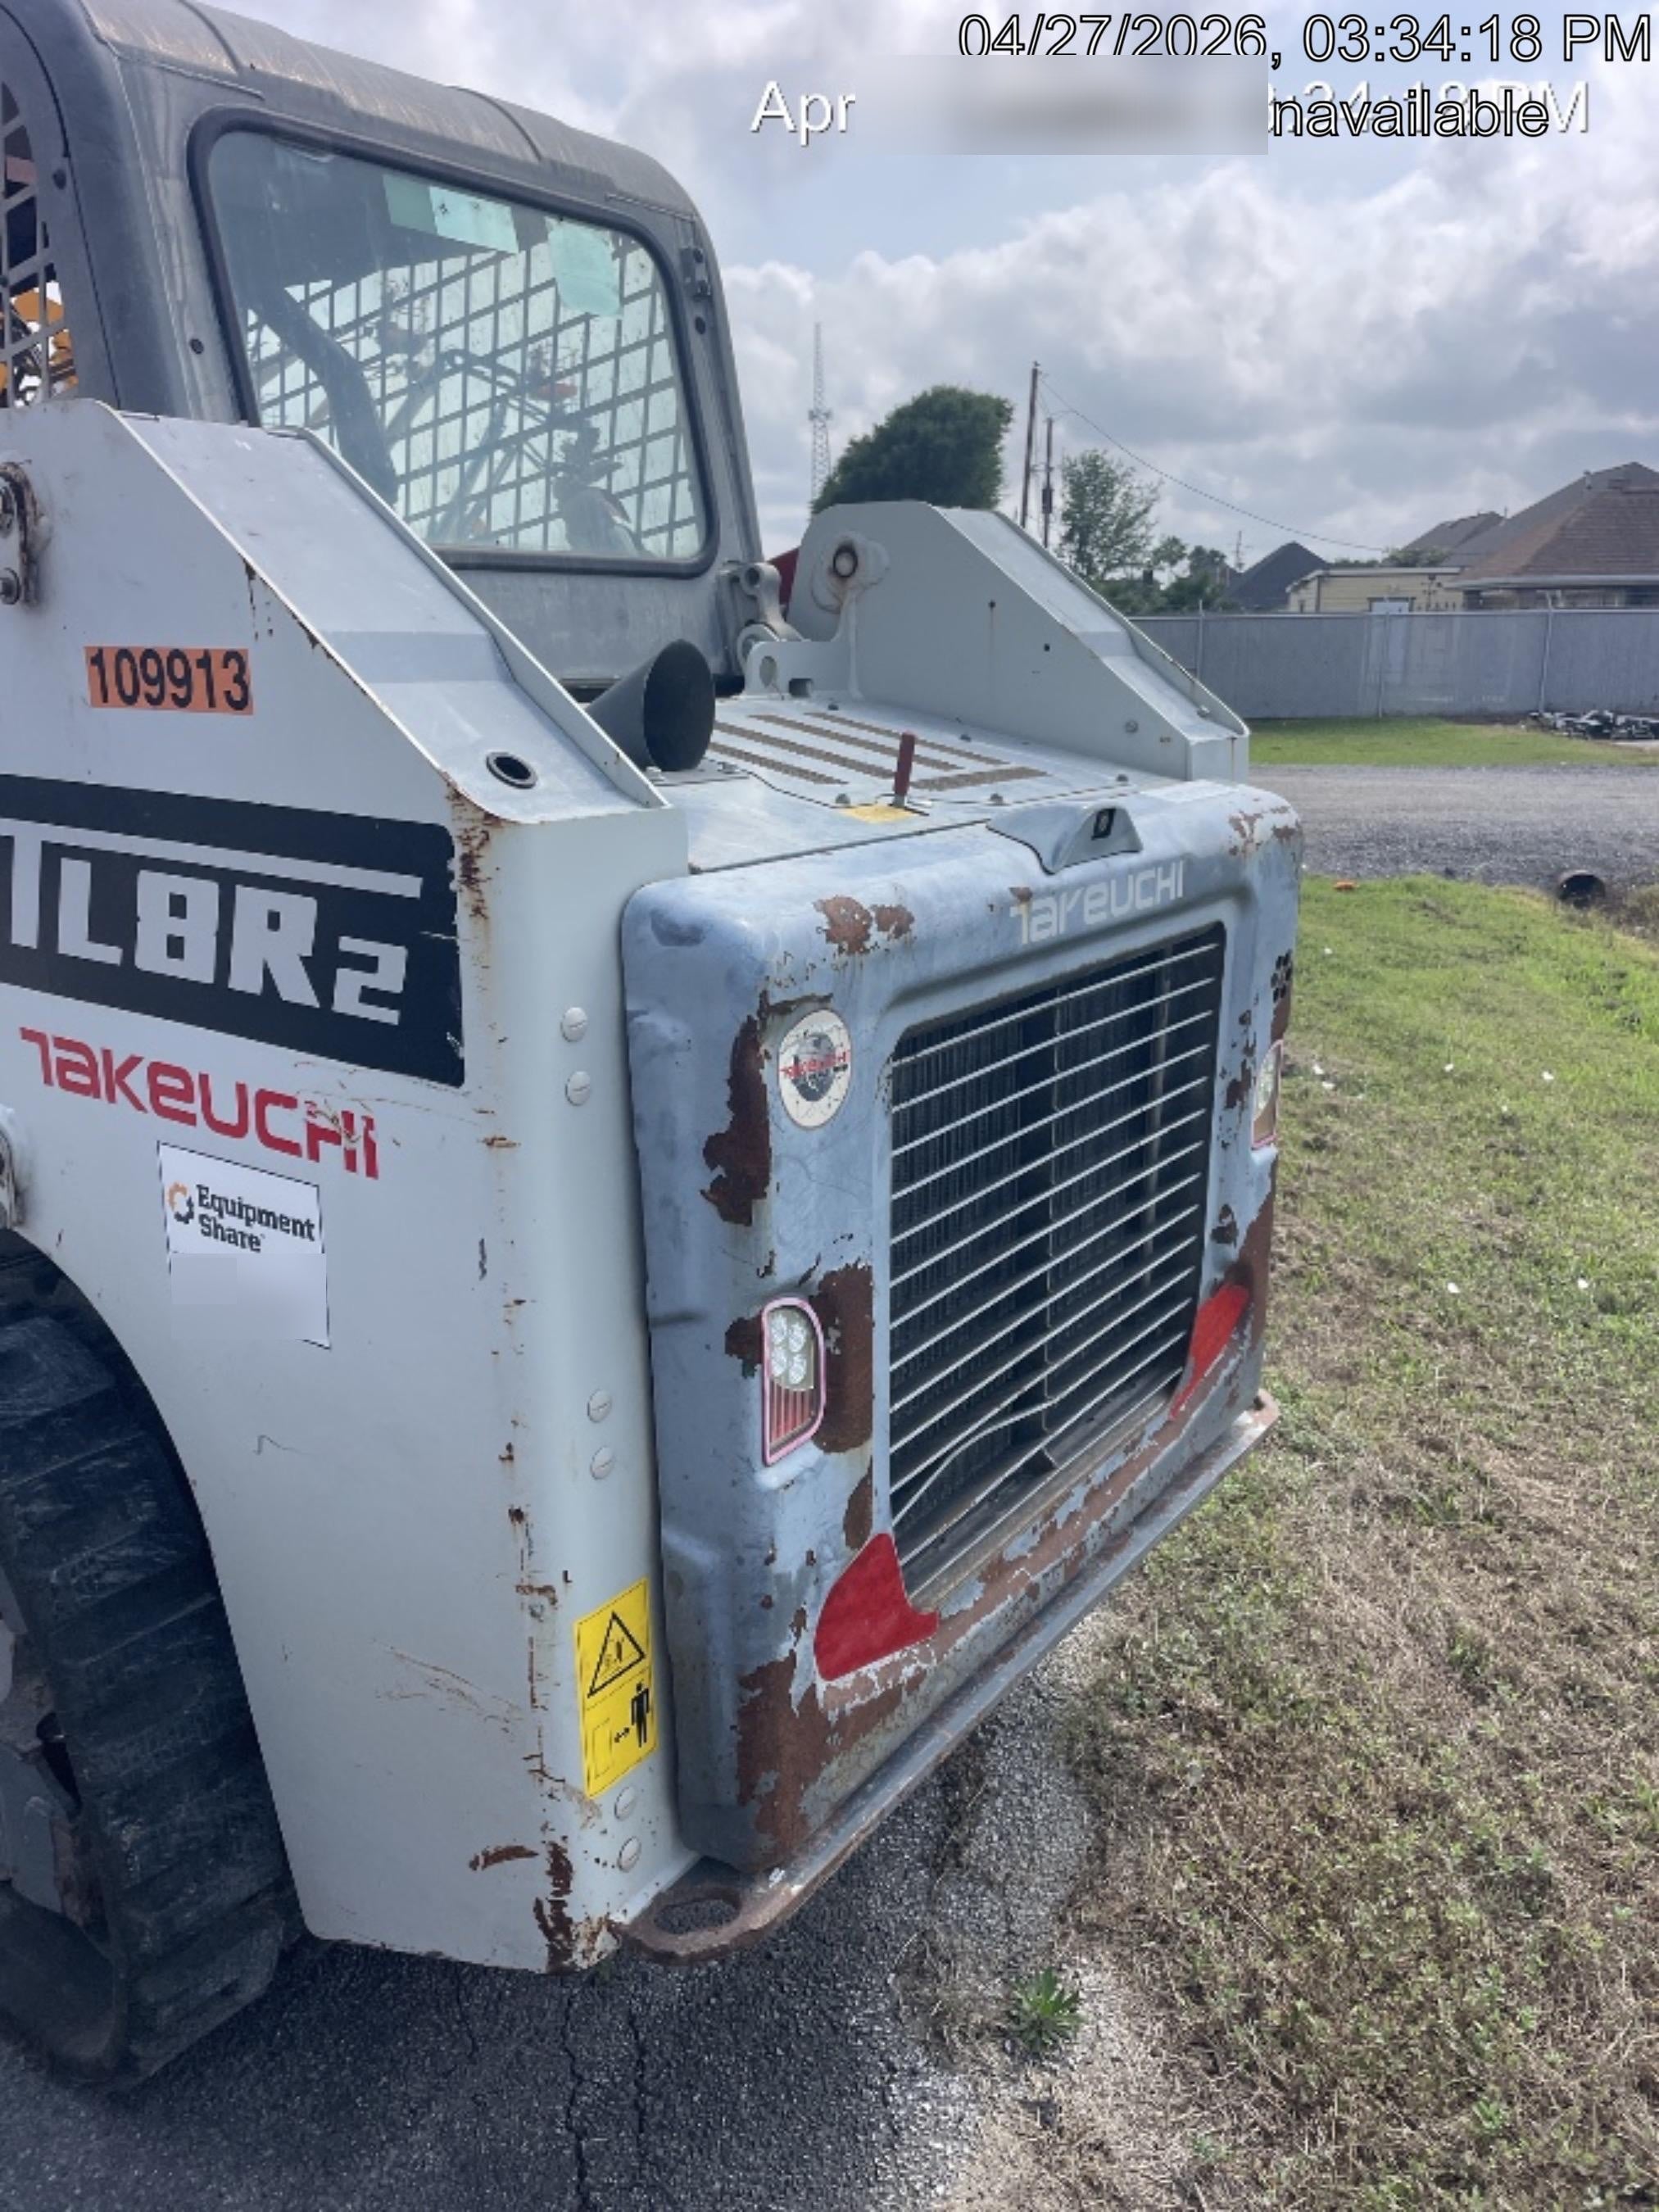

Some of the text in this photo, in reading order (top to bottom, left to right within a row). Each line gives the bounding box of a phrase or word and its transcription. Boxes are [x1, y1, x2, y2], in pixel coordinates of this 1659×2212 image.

[88, 647, 252, 711] 109913
[0, 818, 424, 1026] TL8R2
[196, 1184, 315, 1242] Equipment
[198, 1213, 262, 1253] Share
